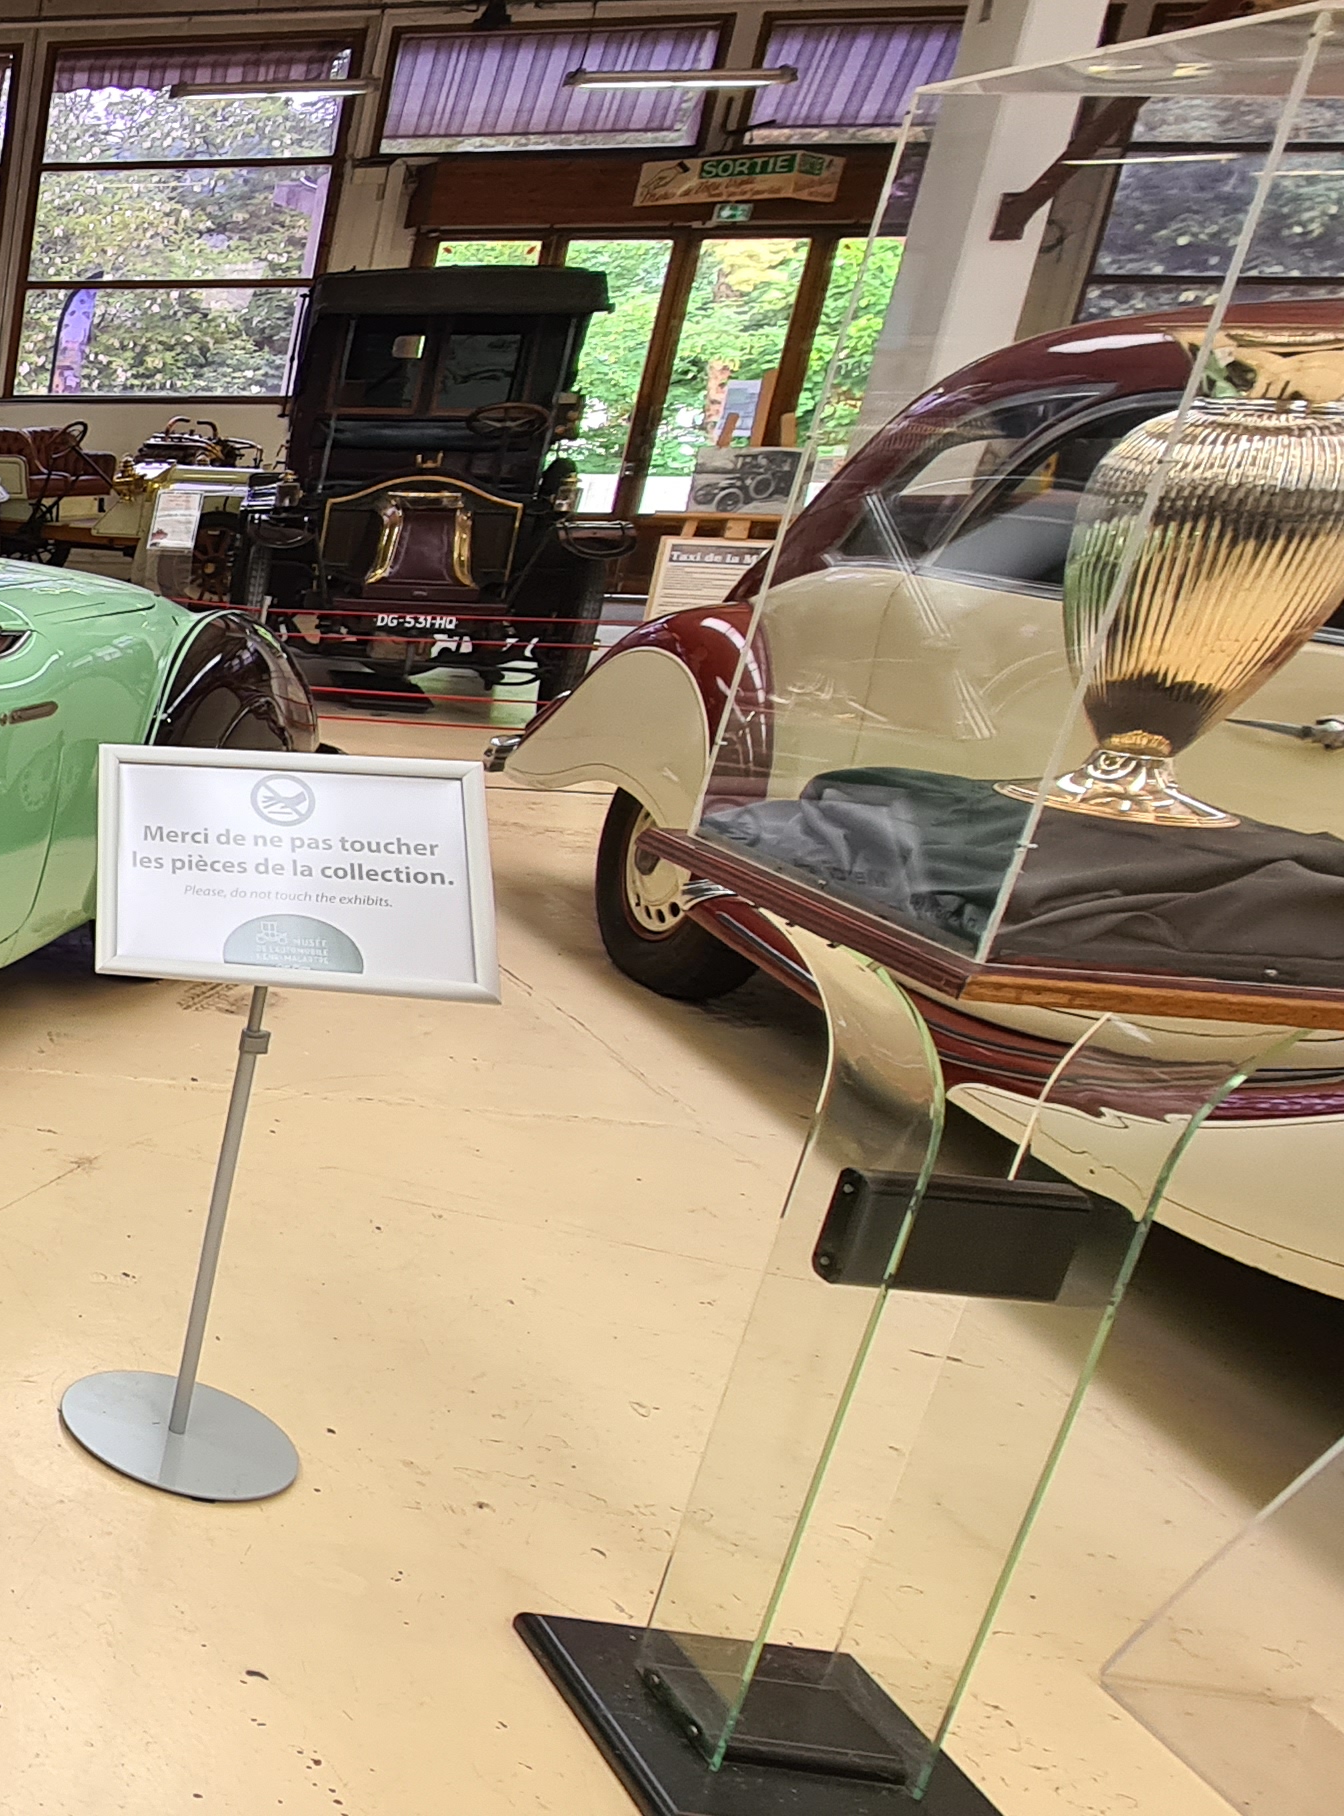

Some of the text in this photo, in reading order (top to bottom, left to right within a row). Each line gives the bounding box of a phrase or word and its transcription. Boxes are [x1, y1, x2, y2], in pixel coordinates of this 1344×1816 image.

[701, 155, 791, 178] SORTIE
[671, 551, 701, 561] Taxi
[704, 553, 722, 563] de
[726, 554, 740, 563] la
[376, 614, 456, 629] DG-531-HQ
[143, 825, 440, 856] Merci de ne pas toucher
[132, 851, 455, 886] les pièces de la collection.
[184, 884, 393, 908] Please, do not touch the exhibits.
